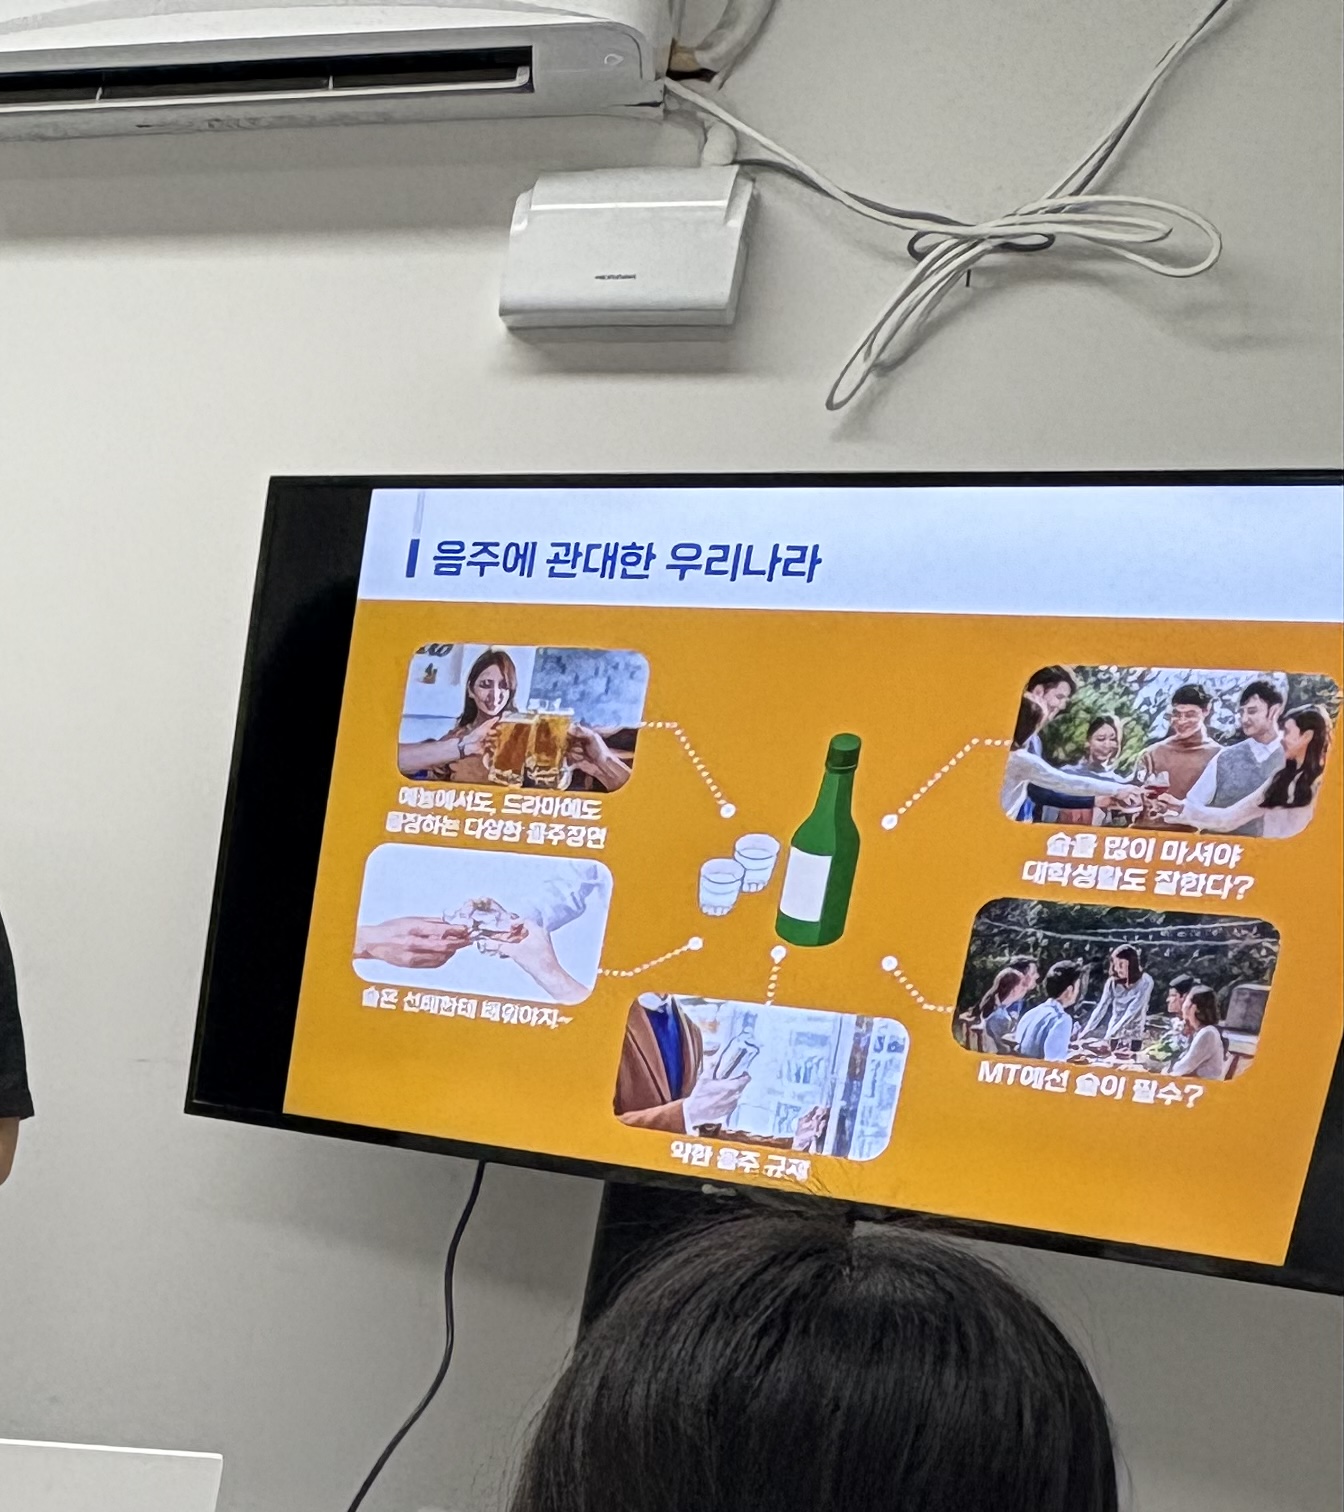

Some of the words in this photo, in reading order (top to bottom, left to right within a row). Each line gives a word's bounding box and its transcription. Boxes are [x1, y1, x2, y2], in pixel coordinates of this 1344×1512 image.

[431, 539, 538, 579] 음주에
[545, 540, 656, 581] 관대한
[665, 542, 823, 584] 우리나라
[1102, 835, 1156, 864] 많이
[1159, 839, 1245, 870] 마셔야
[1020, 860, 1150, 892] 대학생활도
[1153, 869, 1255, 901] 잘한다?
[977, 1060, 1069, 1093] MT에선
[1074, 1073, 1126, 1100] 술이
[1132, 1078, 1204, 1108] 필수?
